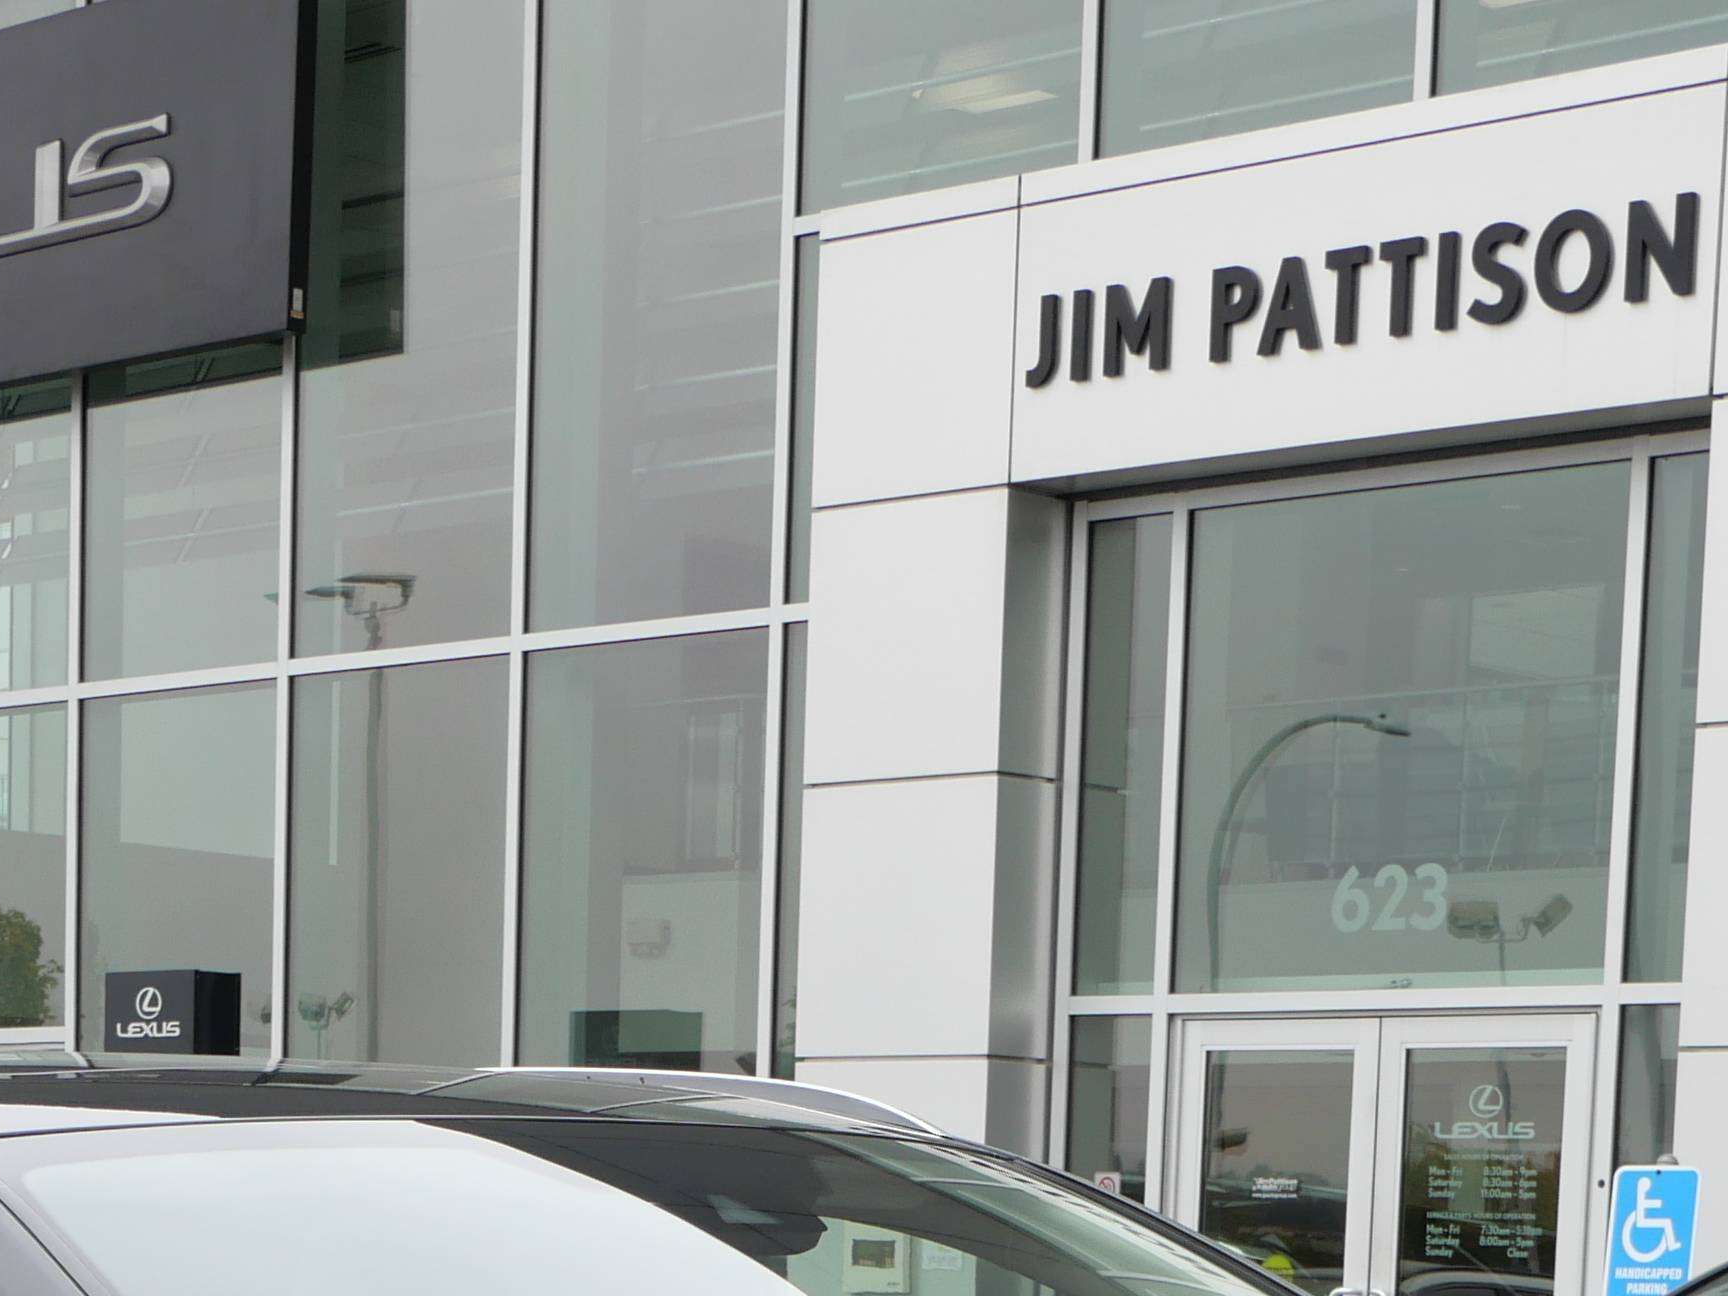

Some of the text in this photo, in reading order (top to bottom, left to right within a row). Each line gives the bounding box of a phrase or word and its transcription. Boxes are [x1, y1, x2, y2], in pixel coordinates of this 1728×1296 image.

[1026, 191, 1701, 389] JIM PATTISON
[1330, 863, 1449, 934] 623
[115, 1021, 181, 1039] LEXUS
[1434, 1122, 1536, 1140] LEXUS
[1615, 1267, 1682, 1280] HANDICAPPED
[1626, 1283, 1668, 1296] PARKING
